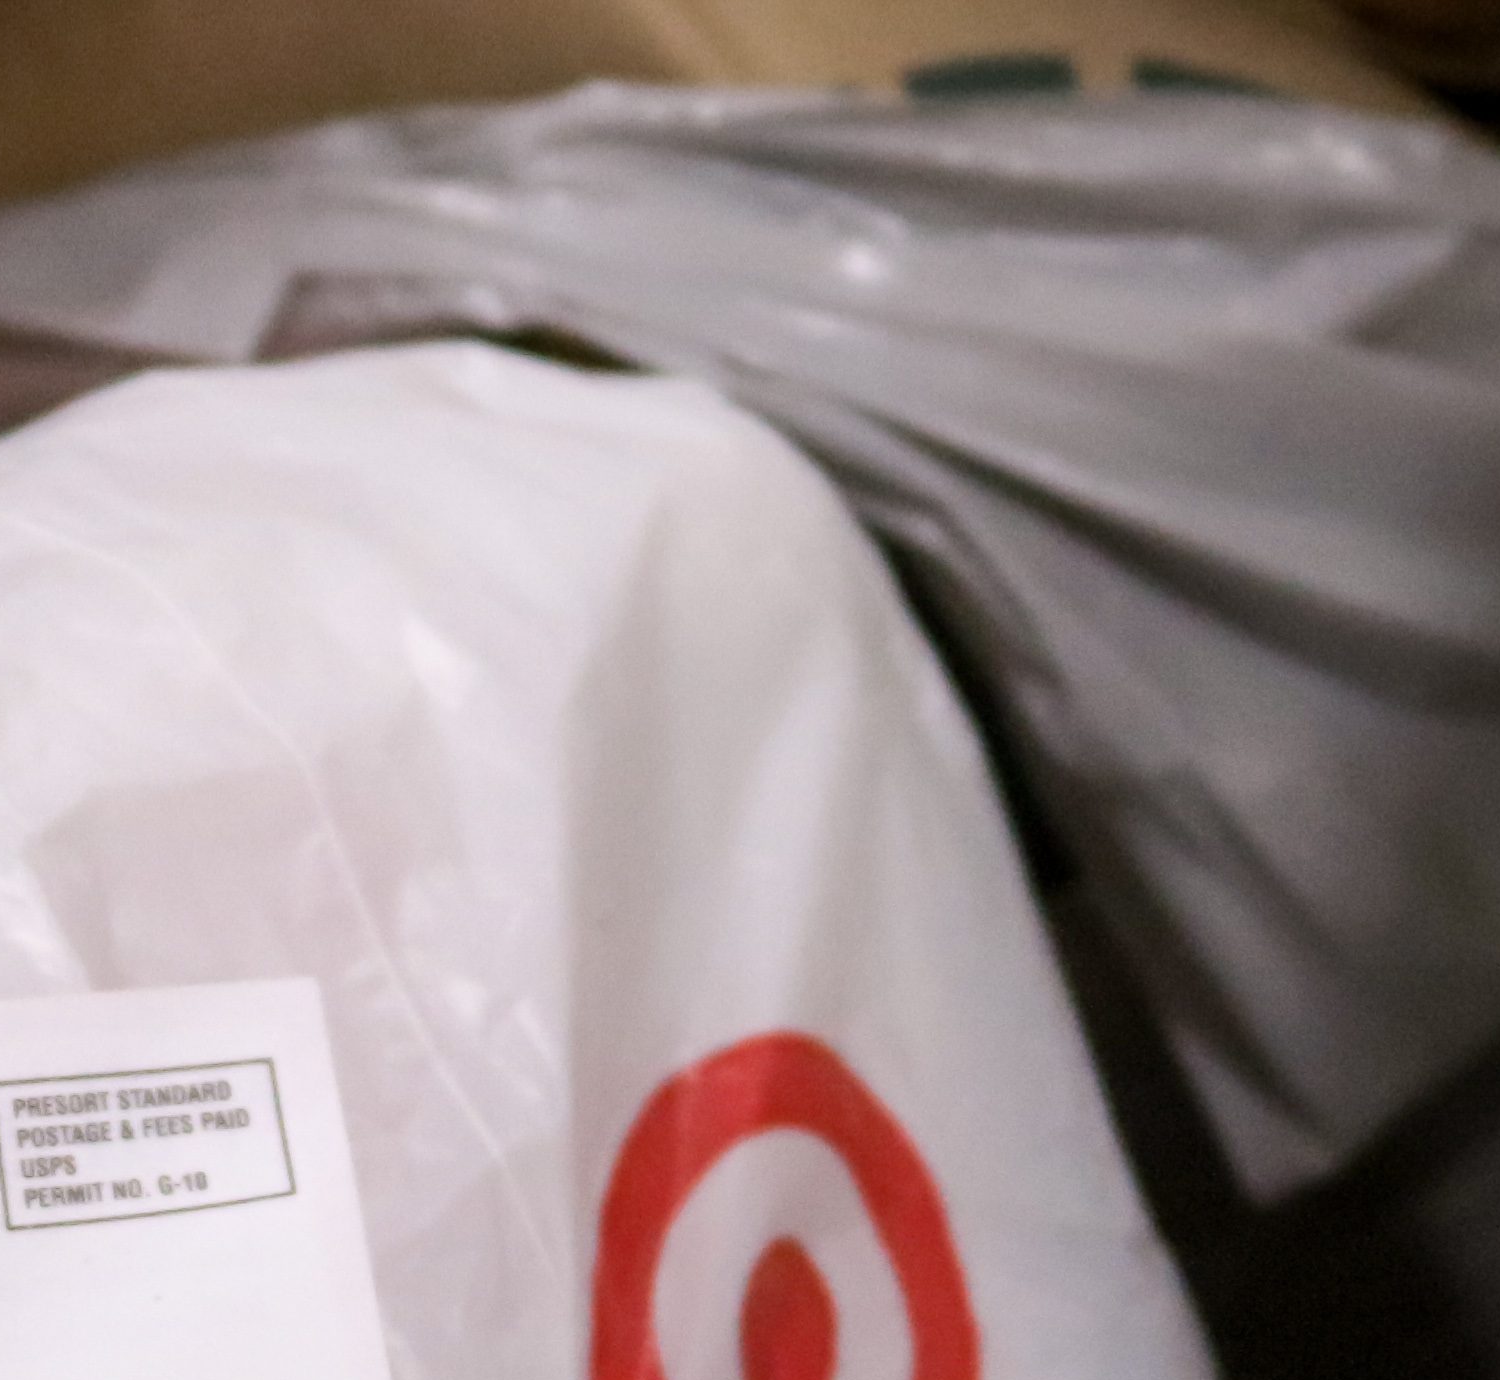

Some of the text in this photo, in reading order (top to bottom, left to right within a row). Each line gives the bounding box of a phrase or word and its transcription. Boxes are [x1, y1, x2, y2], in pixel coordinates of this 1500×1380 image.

[12, 1080, 232, 1118] PRESORT STANDARD
[16, 1107, 251, 1148] POSTAGE & FEES PAID
[20, 1155, 77, 1179] USPS
[23, 1181, 104, 1209] PERMIT
[112, 1179, 151, 1199] NO.
